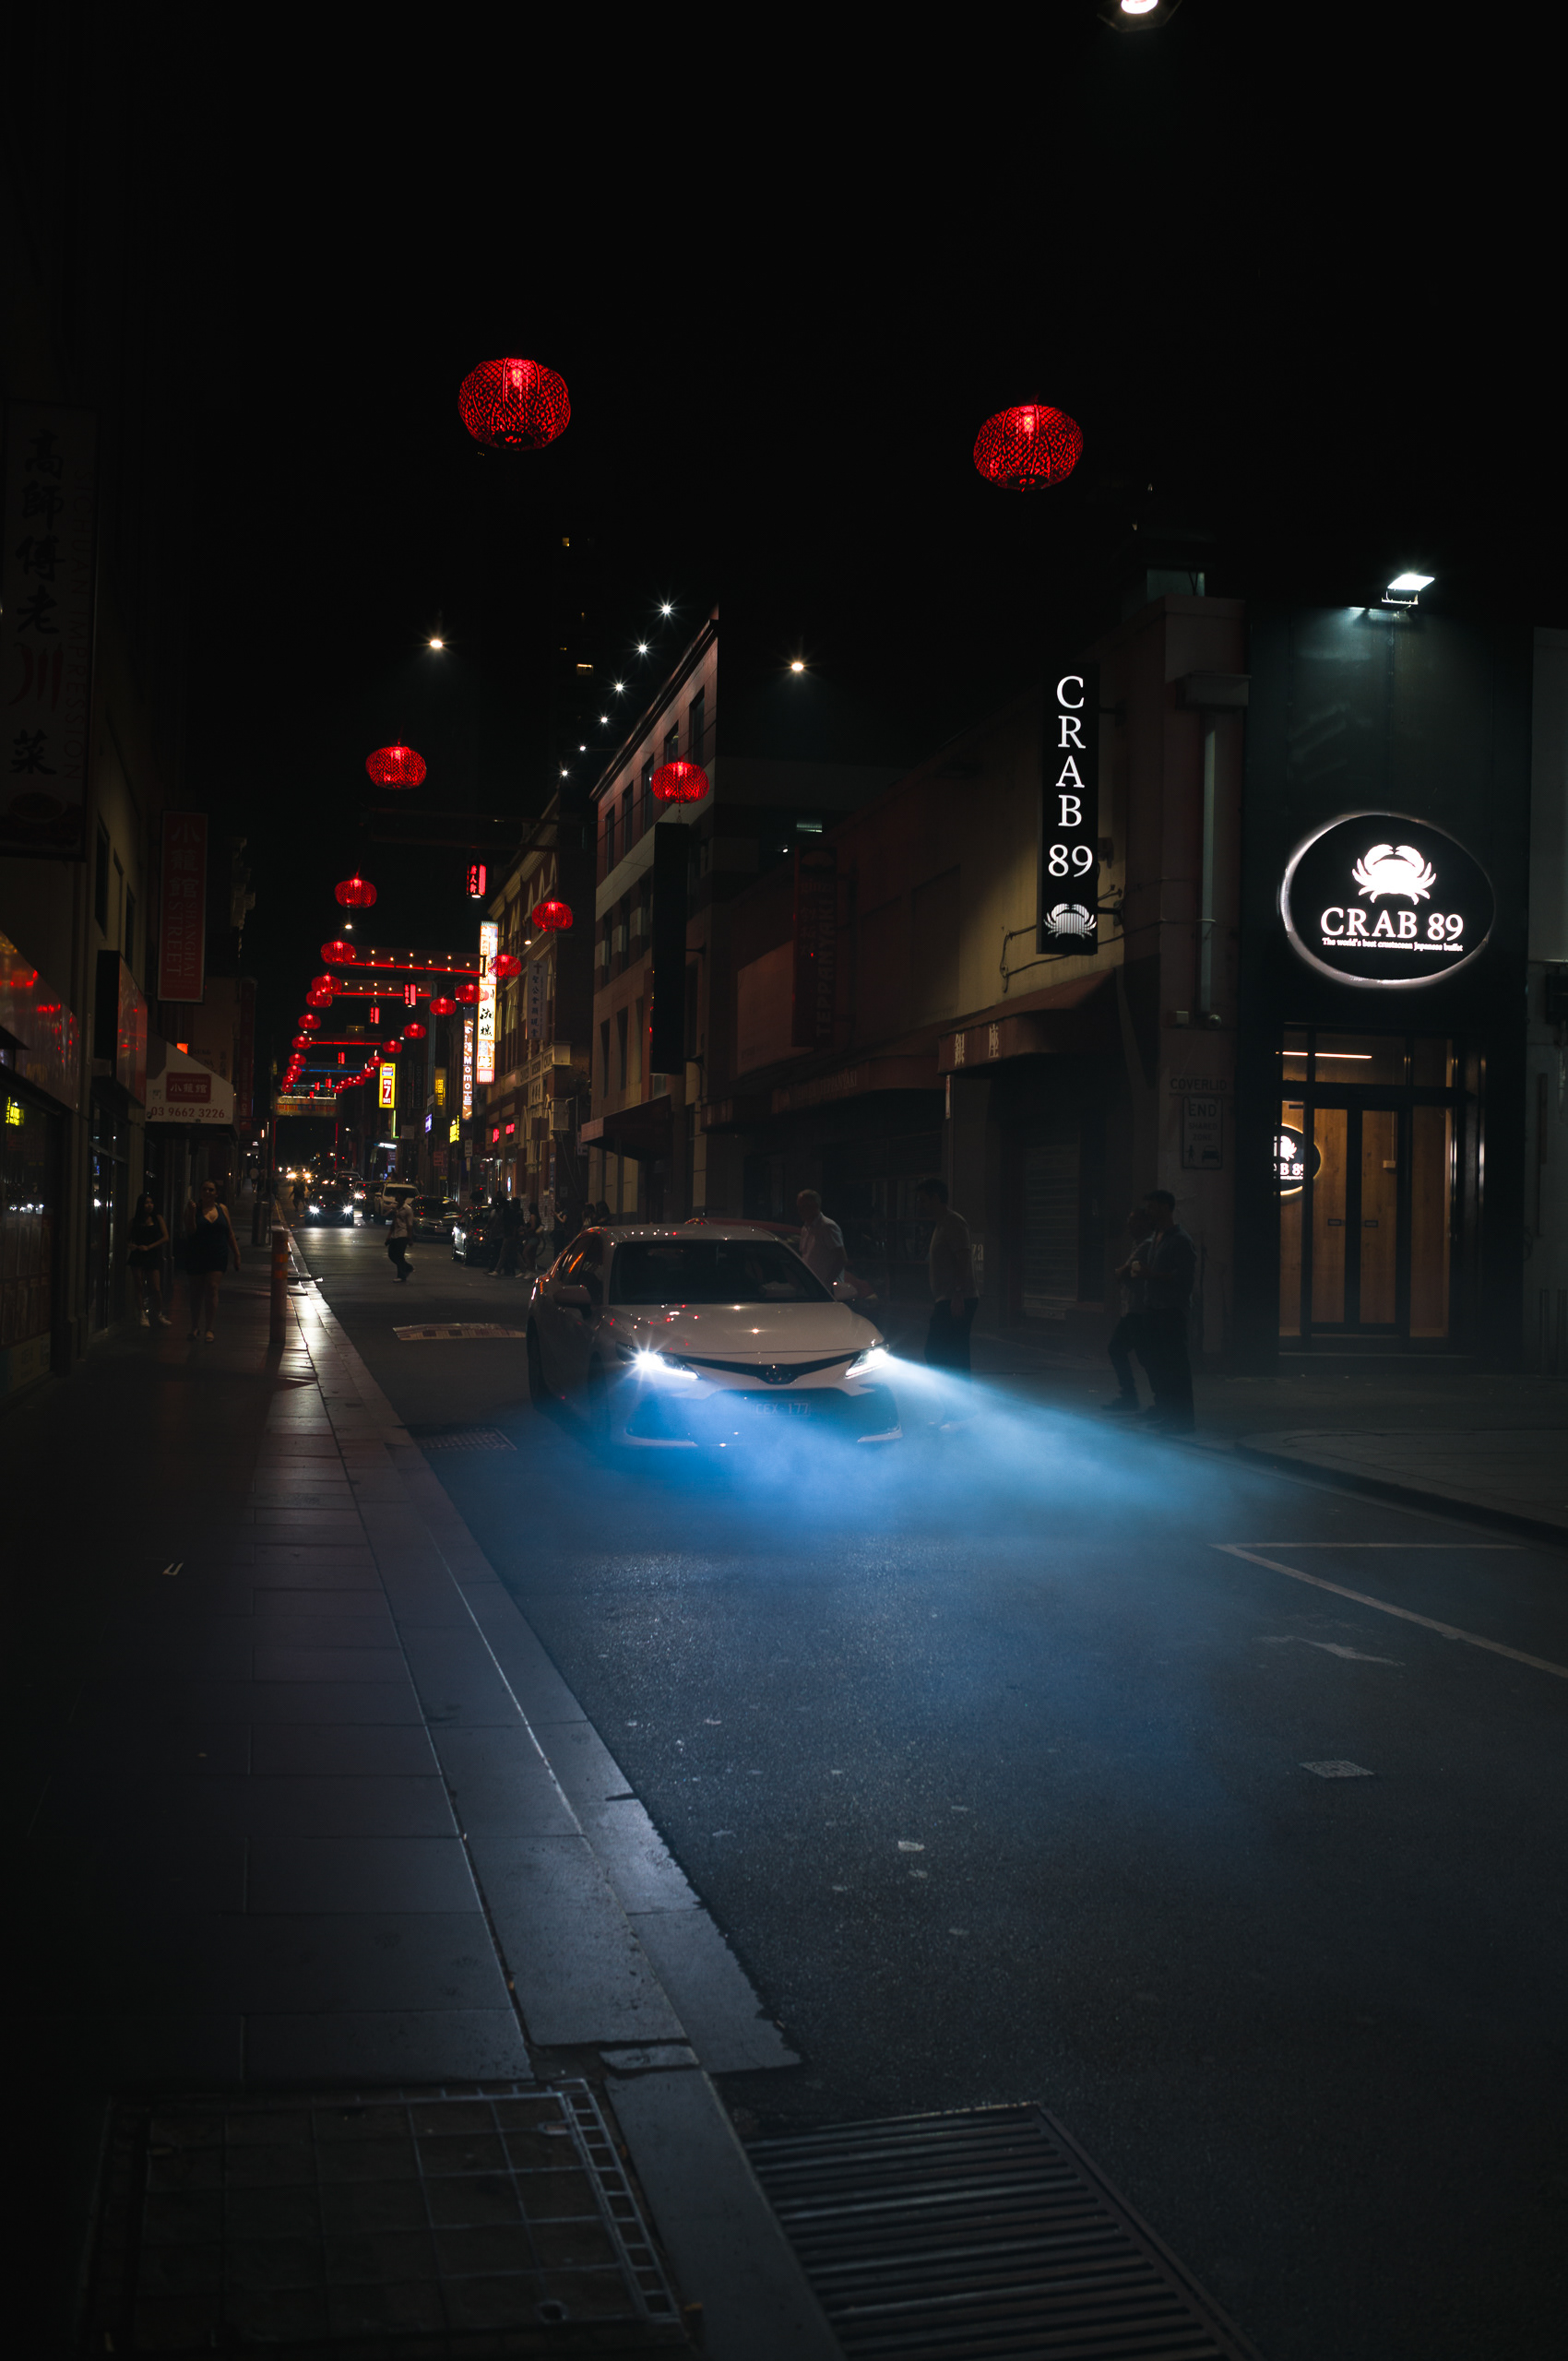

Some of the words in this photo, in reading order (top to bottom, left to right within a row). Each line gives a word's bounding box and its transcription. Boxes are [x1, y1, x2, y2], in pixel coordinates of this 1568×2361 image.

[71, 469, 92, 595] SICHUAN
[64, 611, 89, 780] IMPRESSION
[1055, 675, 1087, 827] CRAB
[1048, 844, 1094, 877] 89
[167, 901, 184, 977] STREET
[184, 901, 197, 978] SHANGHAI
[1321, 908, 1418, 939] CRAB
[1427, 913, 1464, 941] 89
[1322, 937, 1336, 945] The
[1336, 937, 1361, 947] world's
[1362, 939, 1377, 947] best
[815, 898, 835, 1038] TEPPANYAKI
[150, 1107, 164, 1116] 03
[168, 1107, 195, 1118] 9662
[198, 1108, 225, 1119] 3226
[383, 1086, 391, 1097] 7
[1189, 1104, 1217, 1117] END
